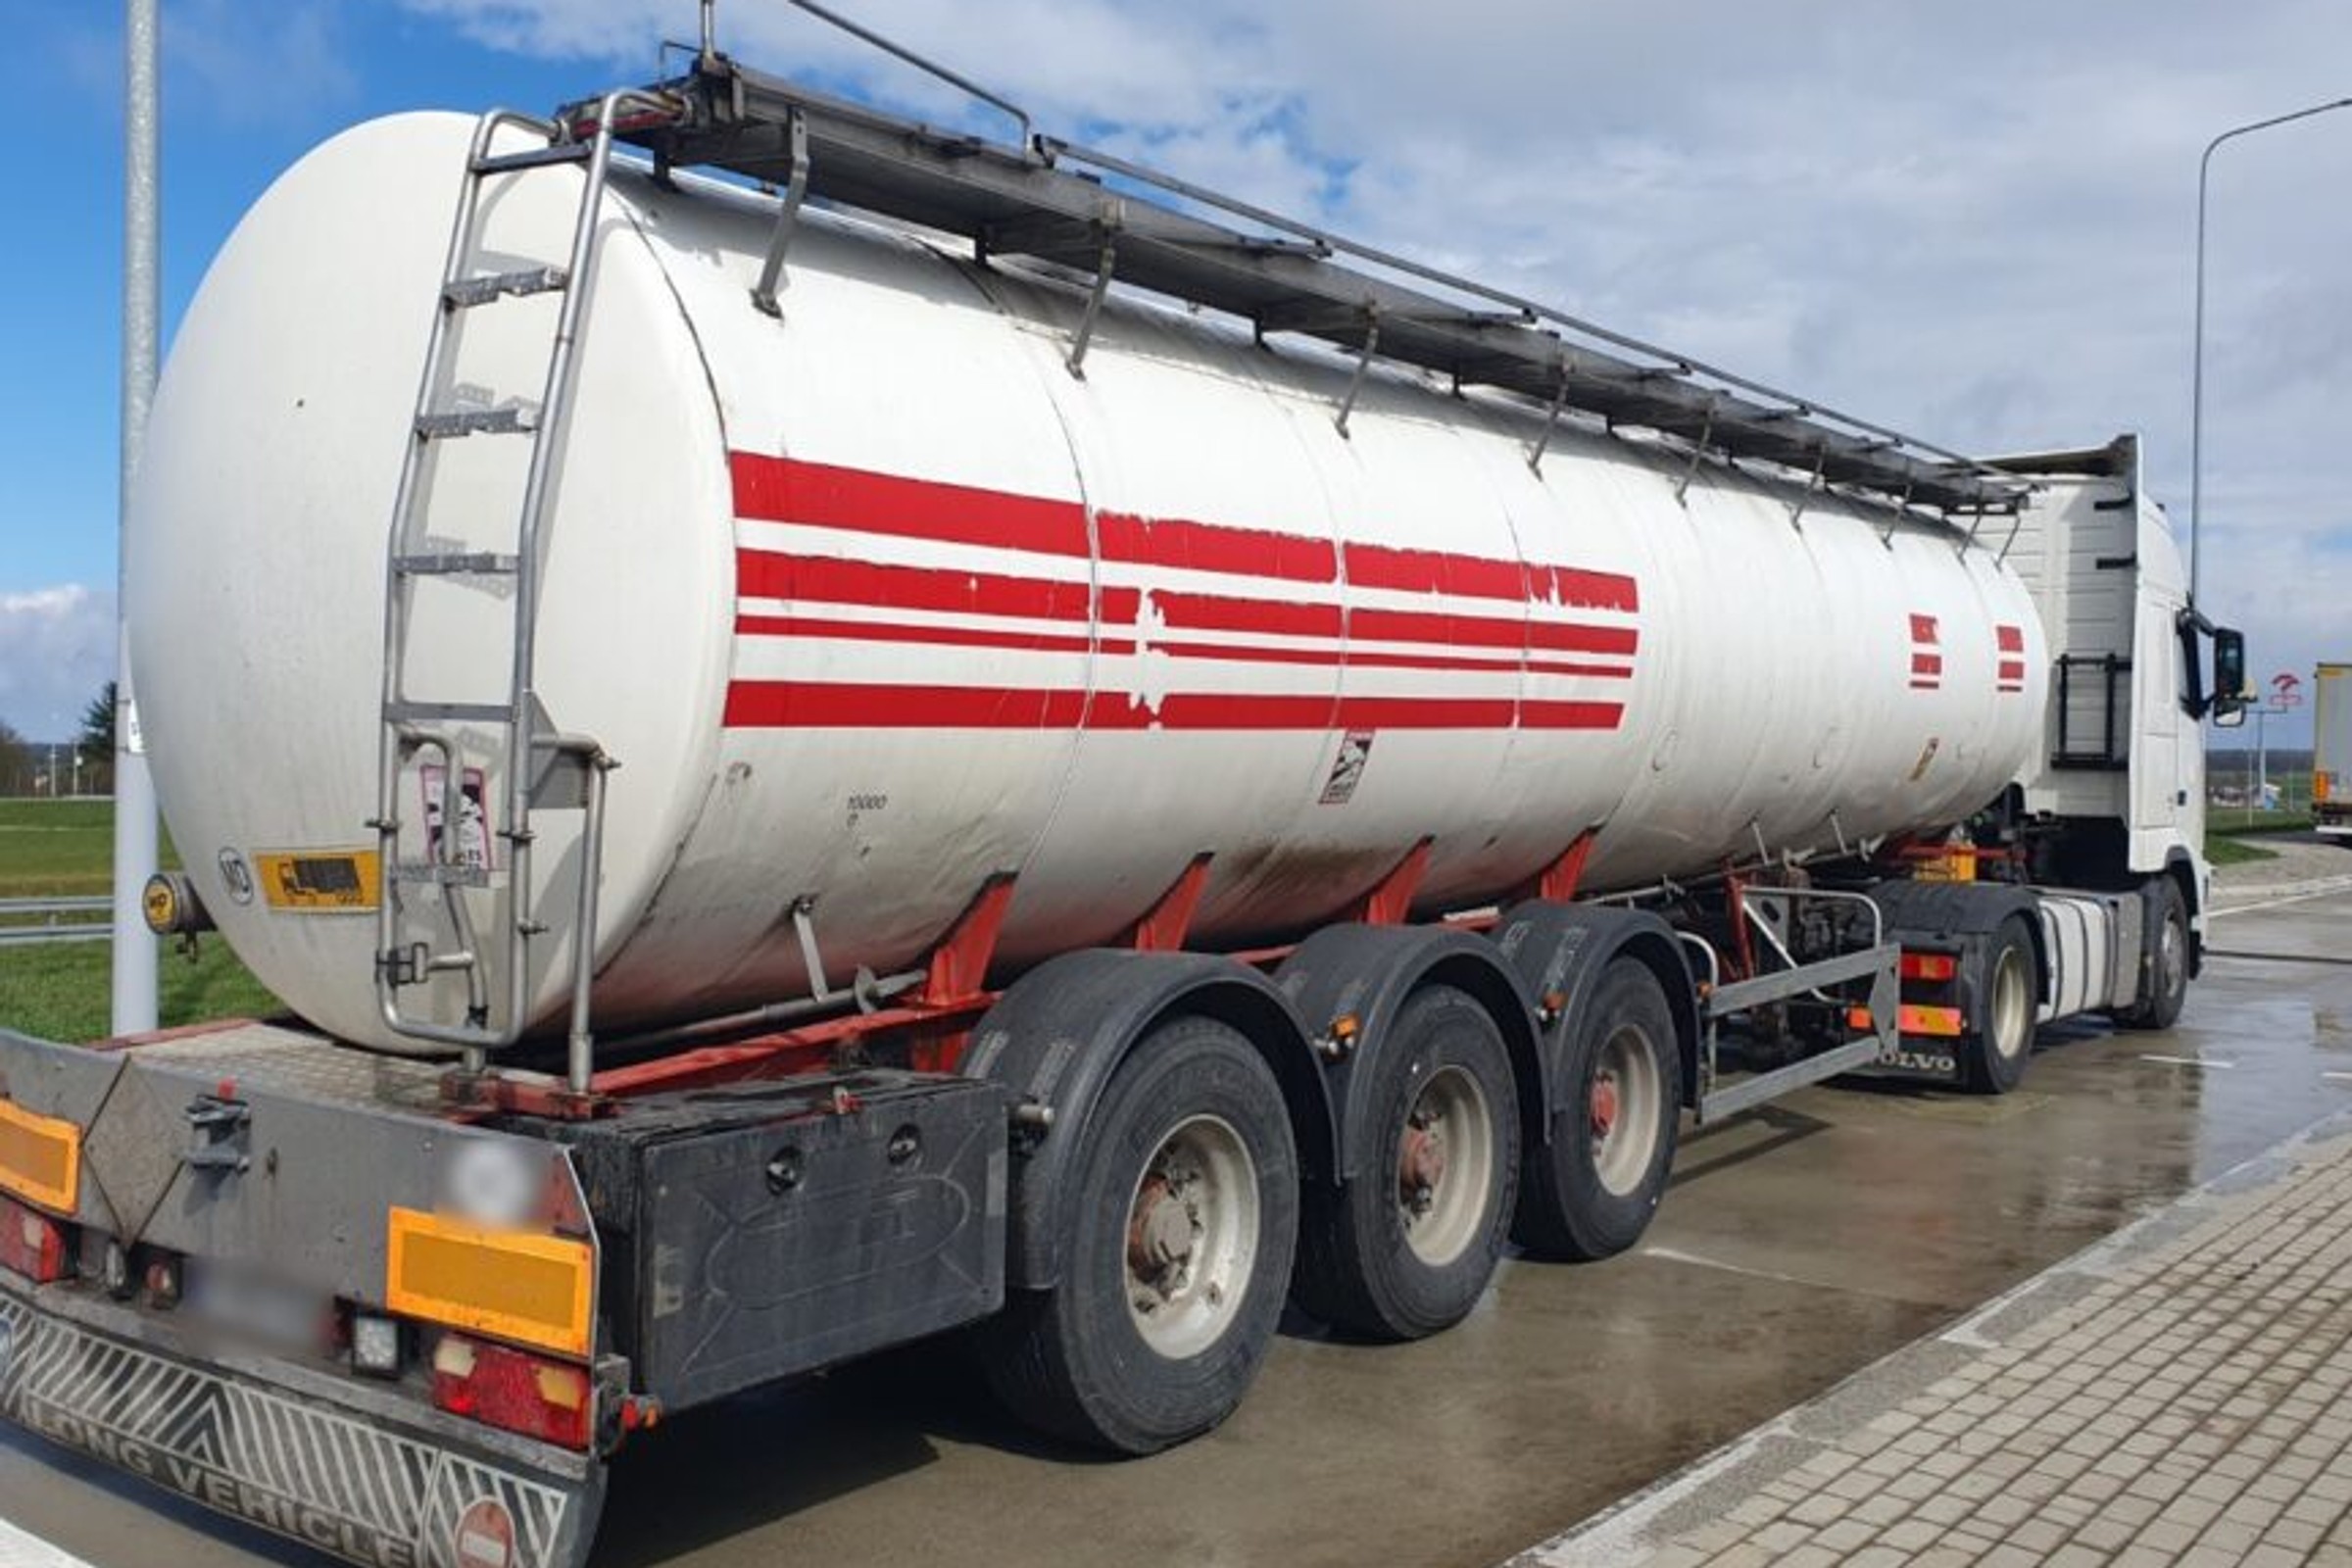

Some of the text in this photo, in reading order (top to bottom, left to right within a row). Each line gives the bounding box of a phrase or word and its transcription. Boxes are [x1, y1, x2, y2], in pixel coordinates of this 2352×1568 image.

[1877, 1051, 1956, 1071] OLVO
[30, 1399, 413, 1567] LONG VEHICLE
